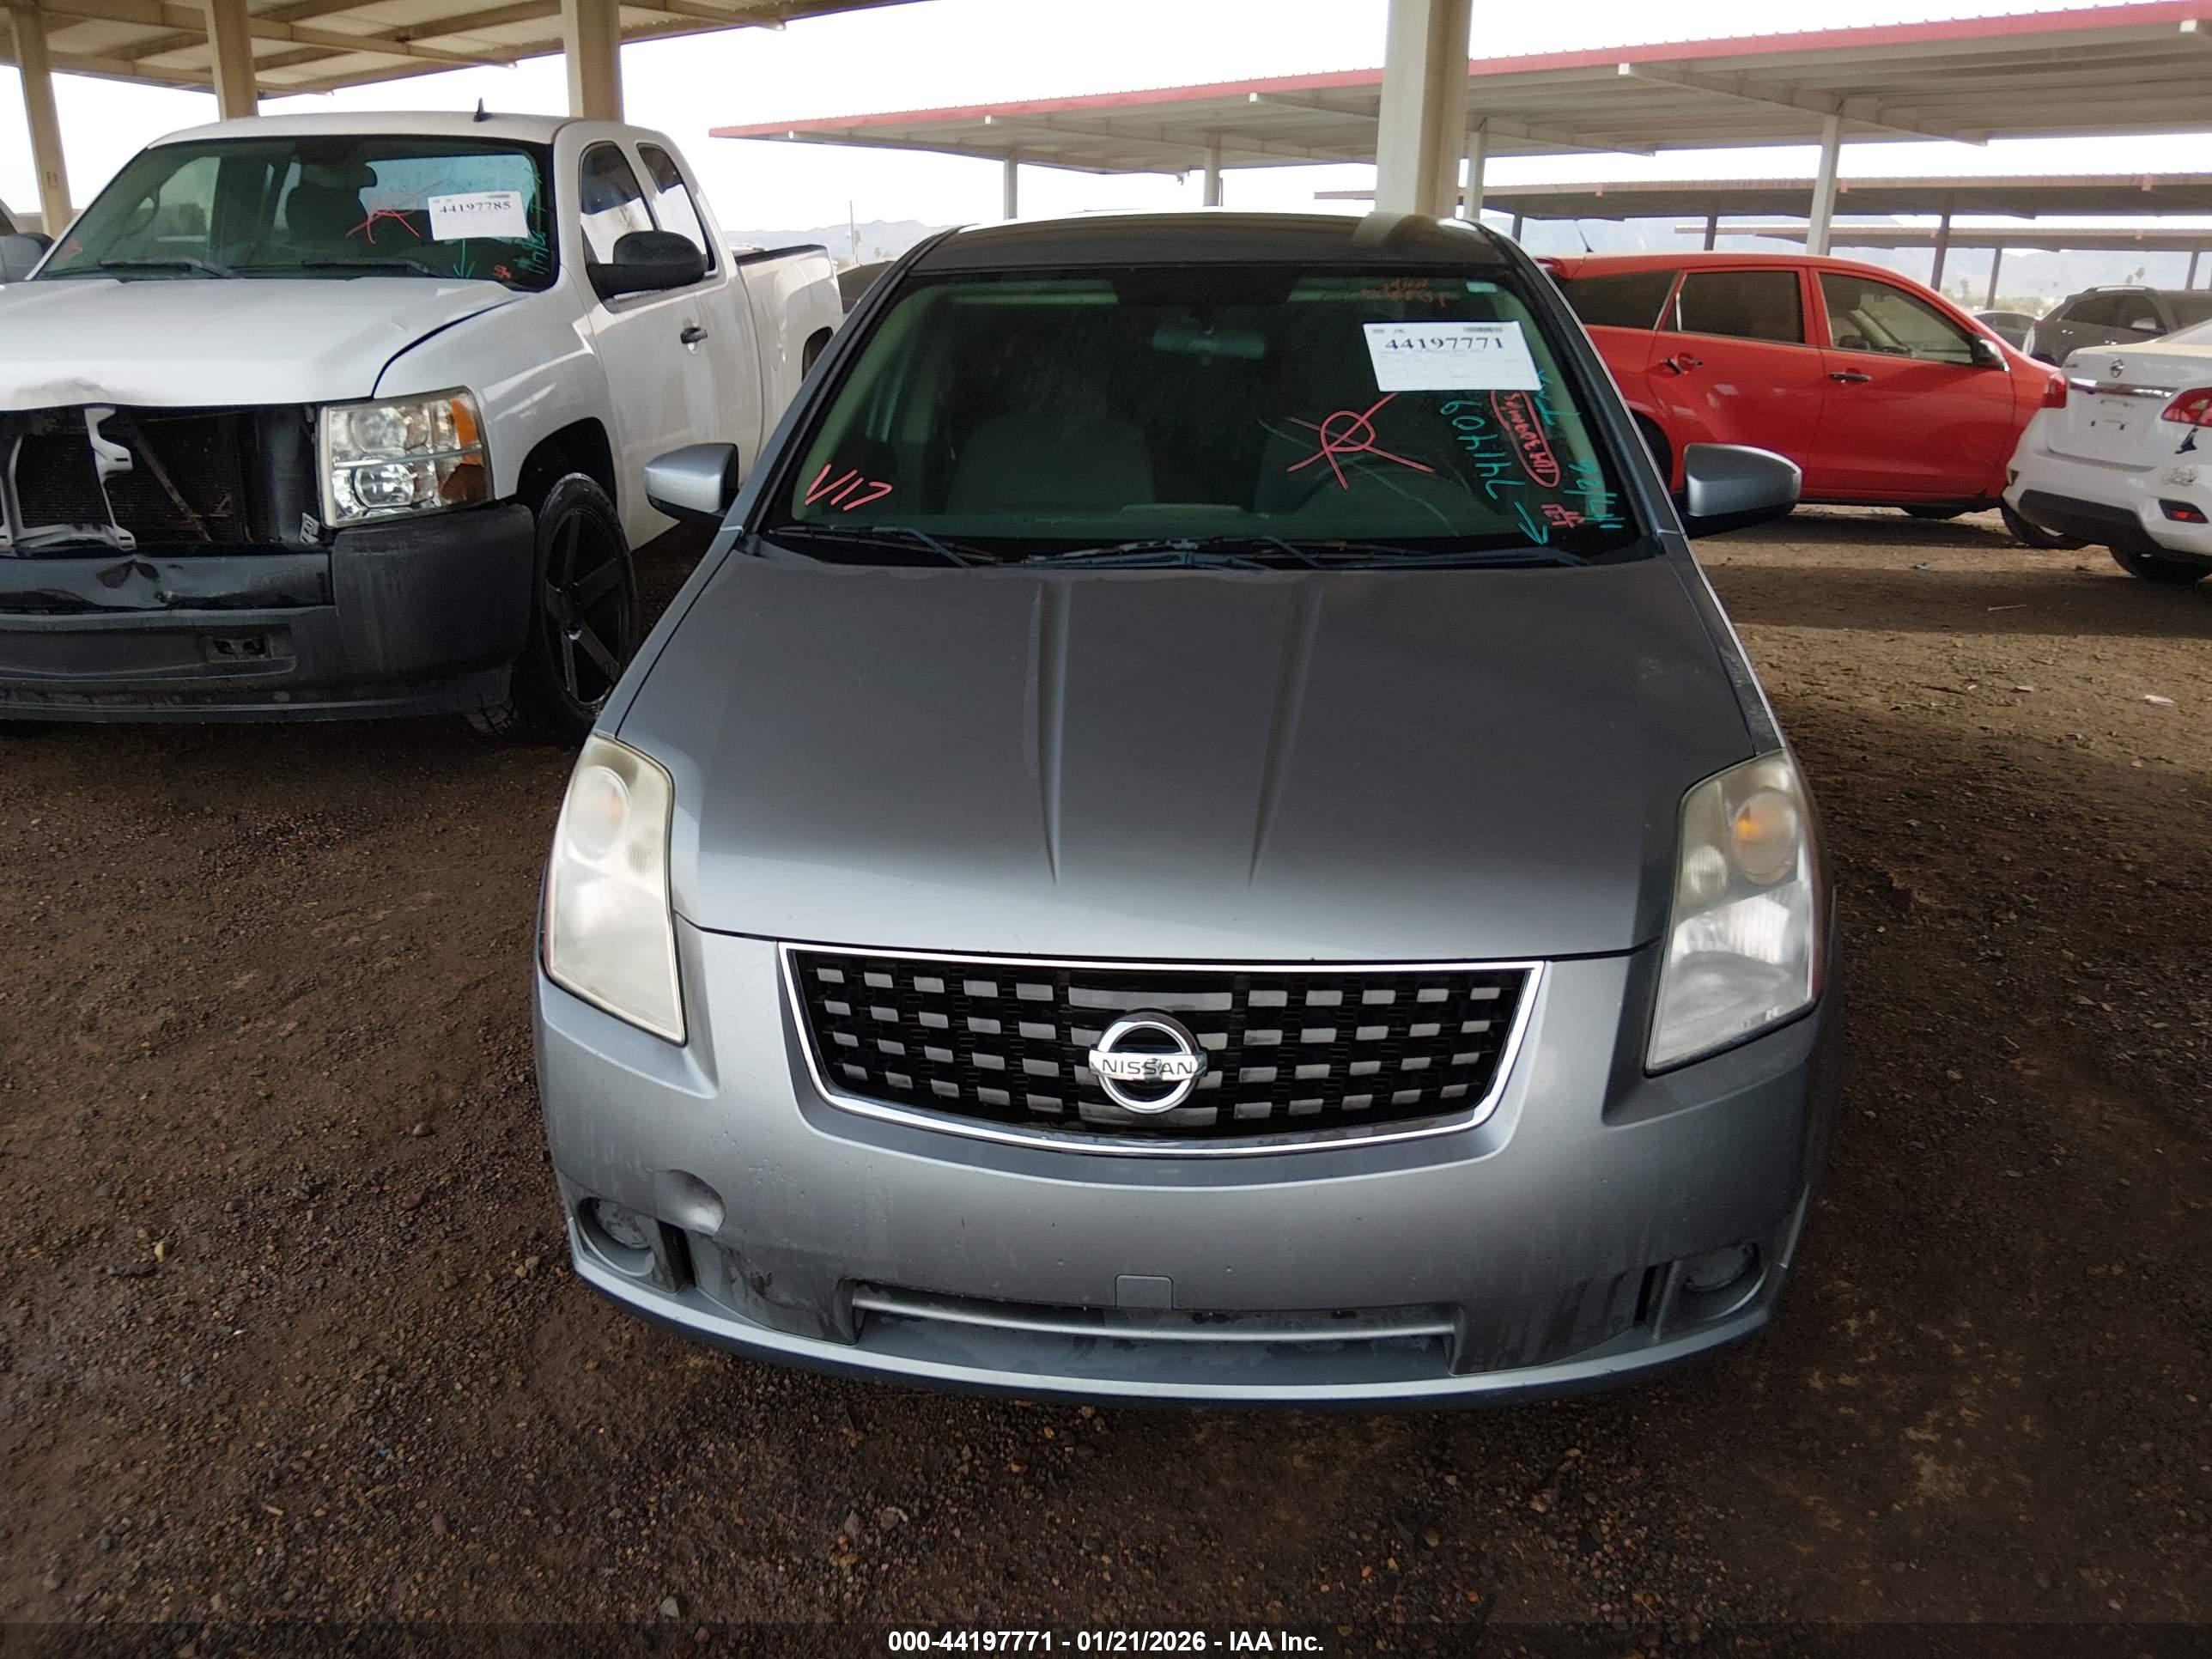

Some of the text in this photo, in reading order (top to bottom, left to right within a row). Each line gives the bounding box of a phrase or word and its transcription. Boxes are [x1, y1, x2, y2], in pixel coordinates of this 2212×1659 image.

[438, 200, 512, 214] 44197785
[1384, 337, 1504, 350] 44197771
[1440, 399, 1525, 499] 741409
[1102, 1059, 1193, 1075] NISSAN
